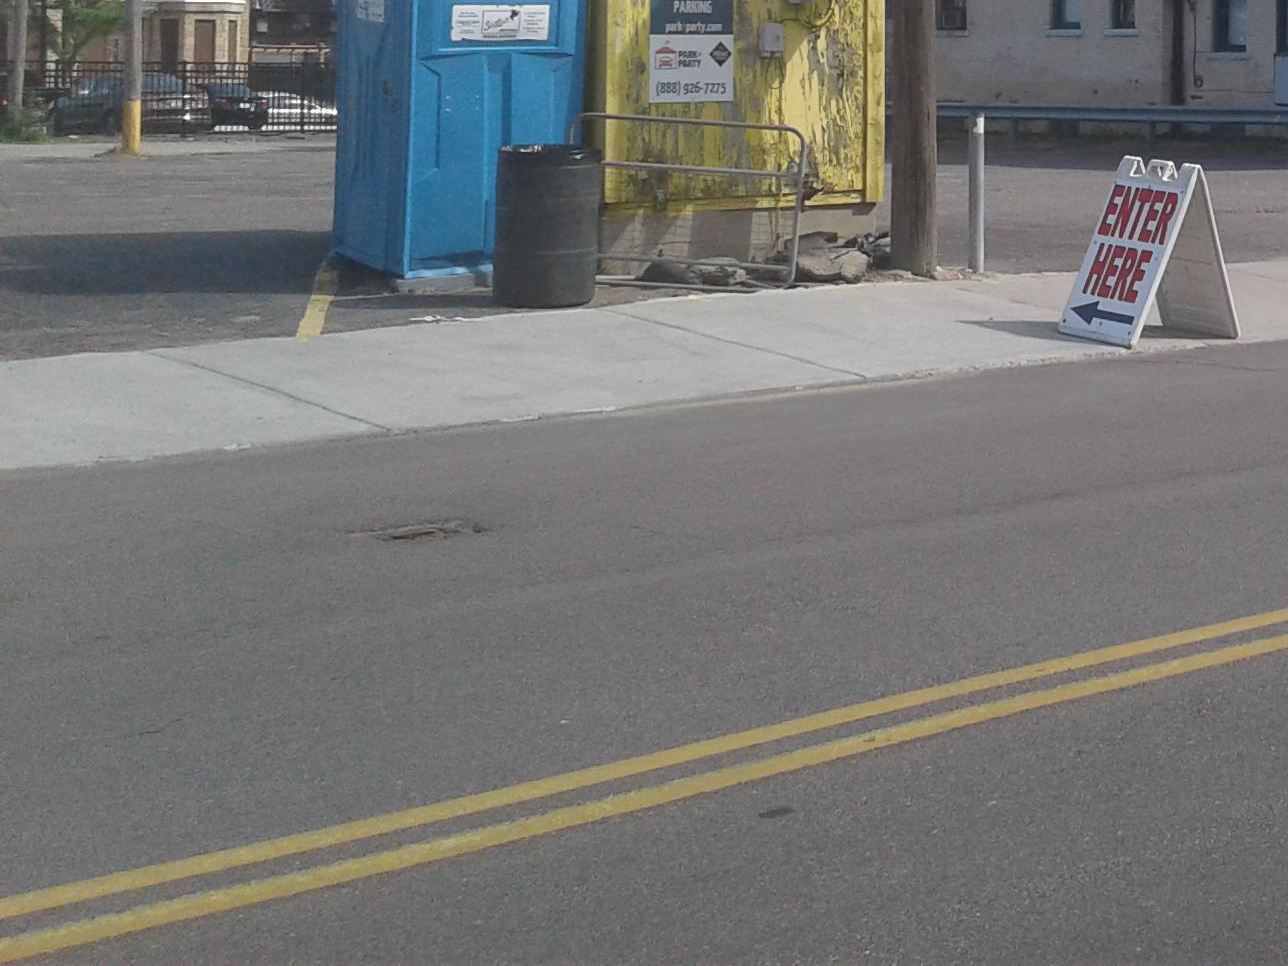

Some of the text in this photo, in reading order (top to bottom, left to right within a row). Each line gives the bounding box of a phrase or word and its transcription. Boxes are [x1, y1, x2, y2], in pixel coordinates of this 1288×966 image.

[673, 0, 713, 14] PARKING
[678, 50, 699, 59] PARK
[678, 59, 702, 68] PARTY
[656, 81, 727, 96] (888) 926-7275
[1098, 184, 1179, 246] ENTER
[1082, 242, 1154, 304] HERE
